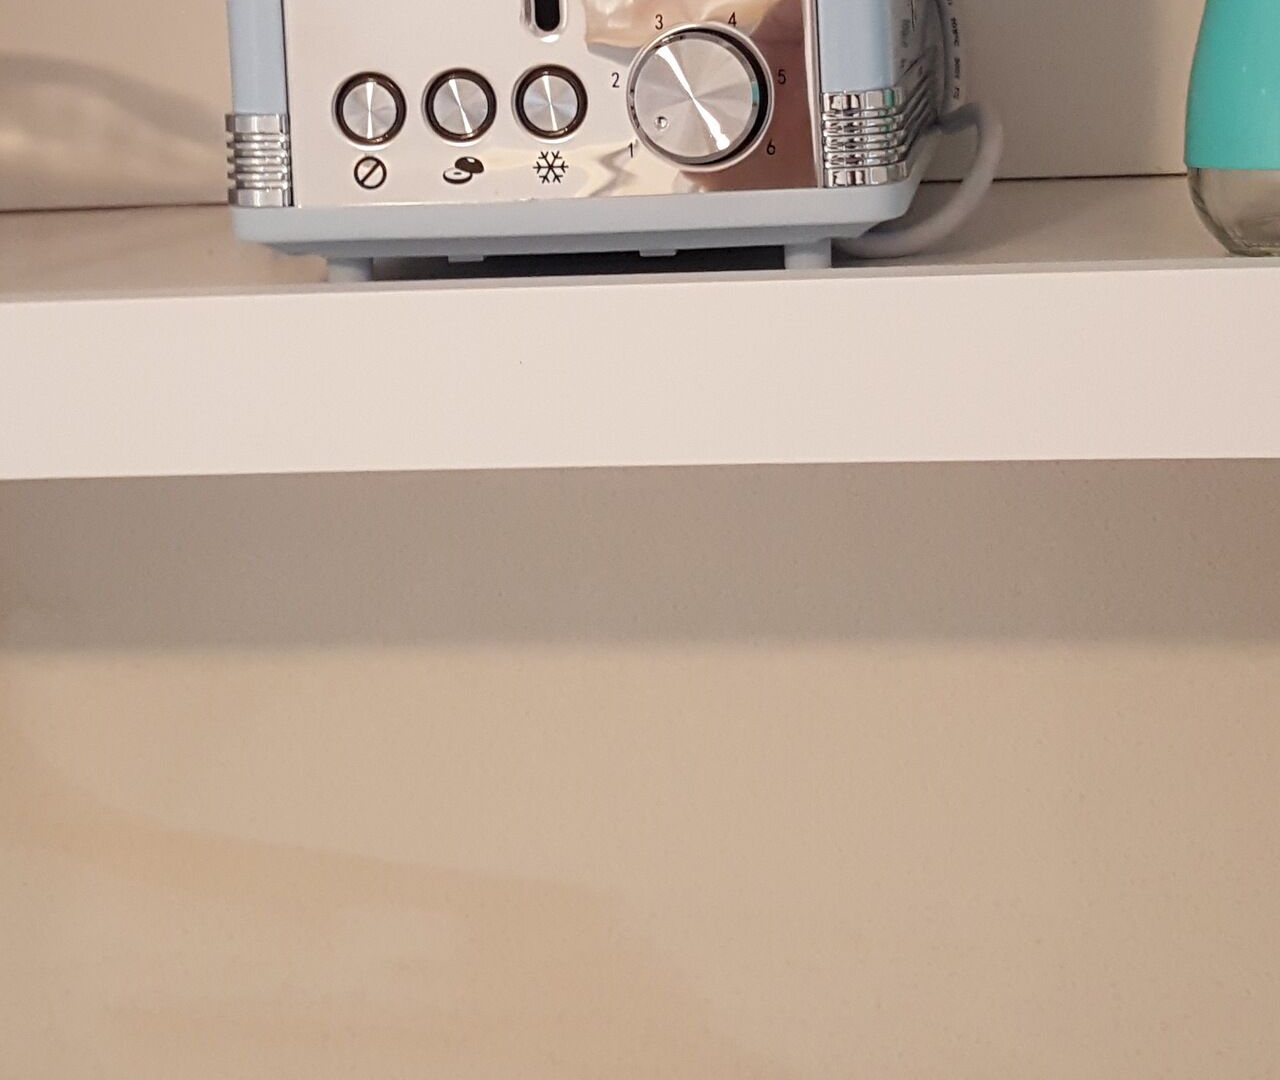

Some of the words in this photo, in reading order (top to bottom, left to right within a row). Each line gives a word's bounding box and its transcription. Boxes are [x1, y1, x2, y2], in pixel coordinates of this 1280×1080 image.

[654, 14, 664, 30] 3
[727, 11, 737, 28] 4
[611, 71, 620, 88] 2
[777, 68, 787, 85] 5
[627, 142, 634, 158] 1
[766, 138, 776, 156] 6
